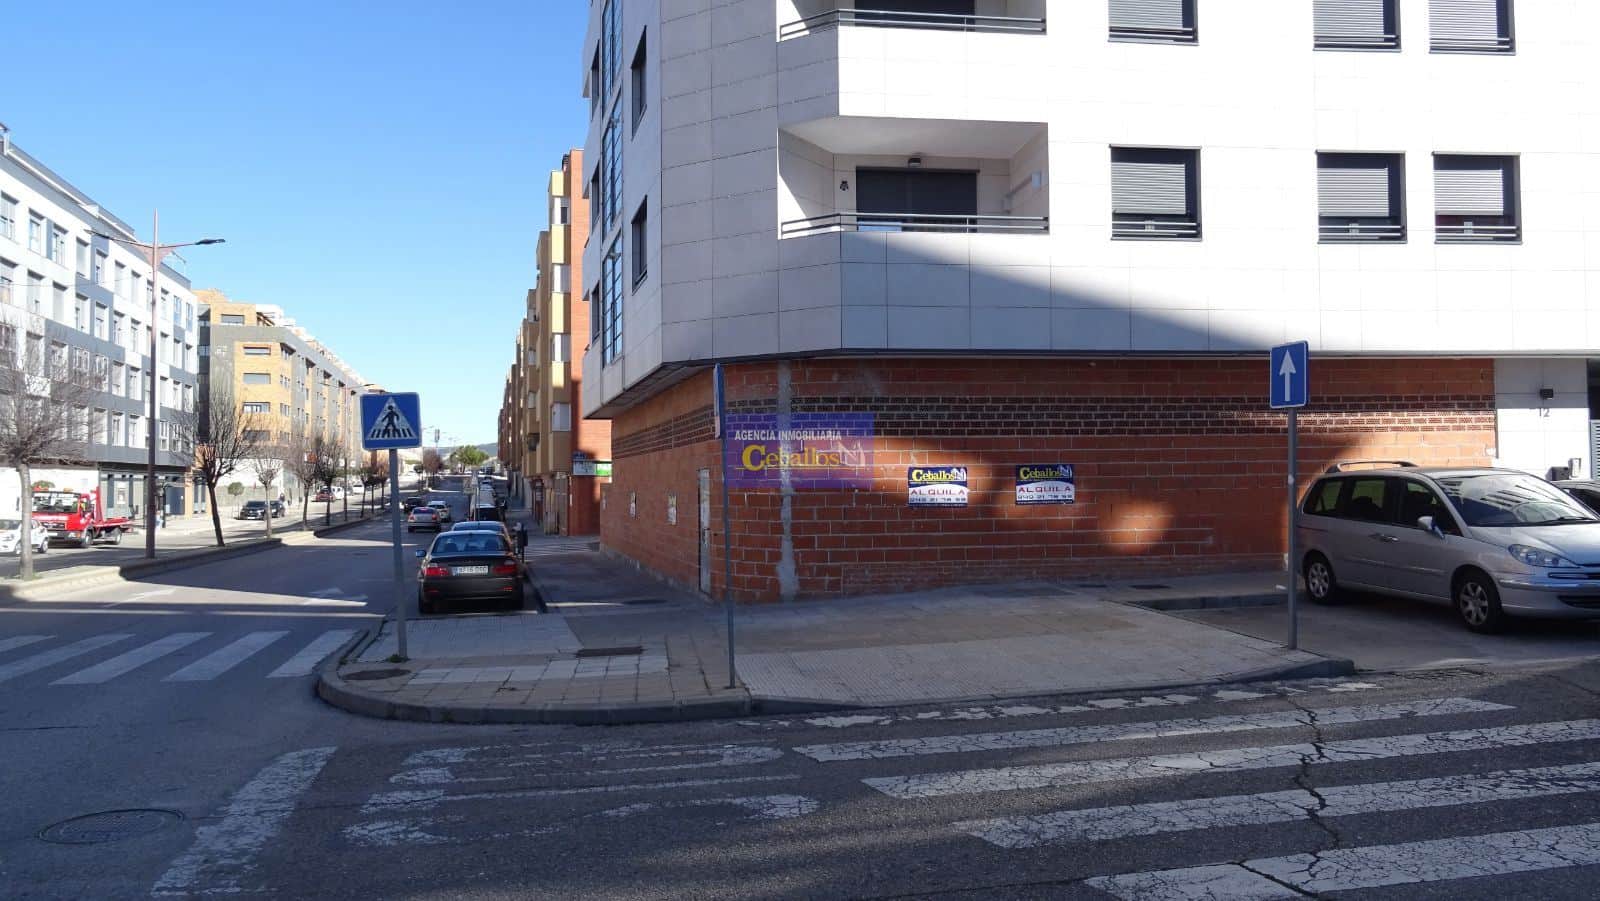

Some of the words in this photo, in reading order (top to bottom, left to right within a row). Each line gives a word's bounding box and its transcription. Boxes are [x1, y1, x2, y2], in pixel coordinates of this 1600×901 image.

[911, 469, 956, 482] Ceballos
[1019, 467, 1063, 480] Ceballos
[910, 488, 965, 496] ALQUILA
[1018, 485, 1071, 494] ALQUILA
